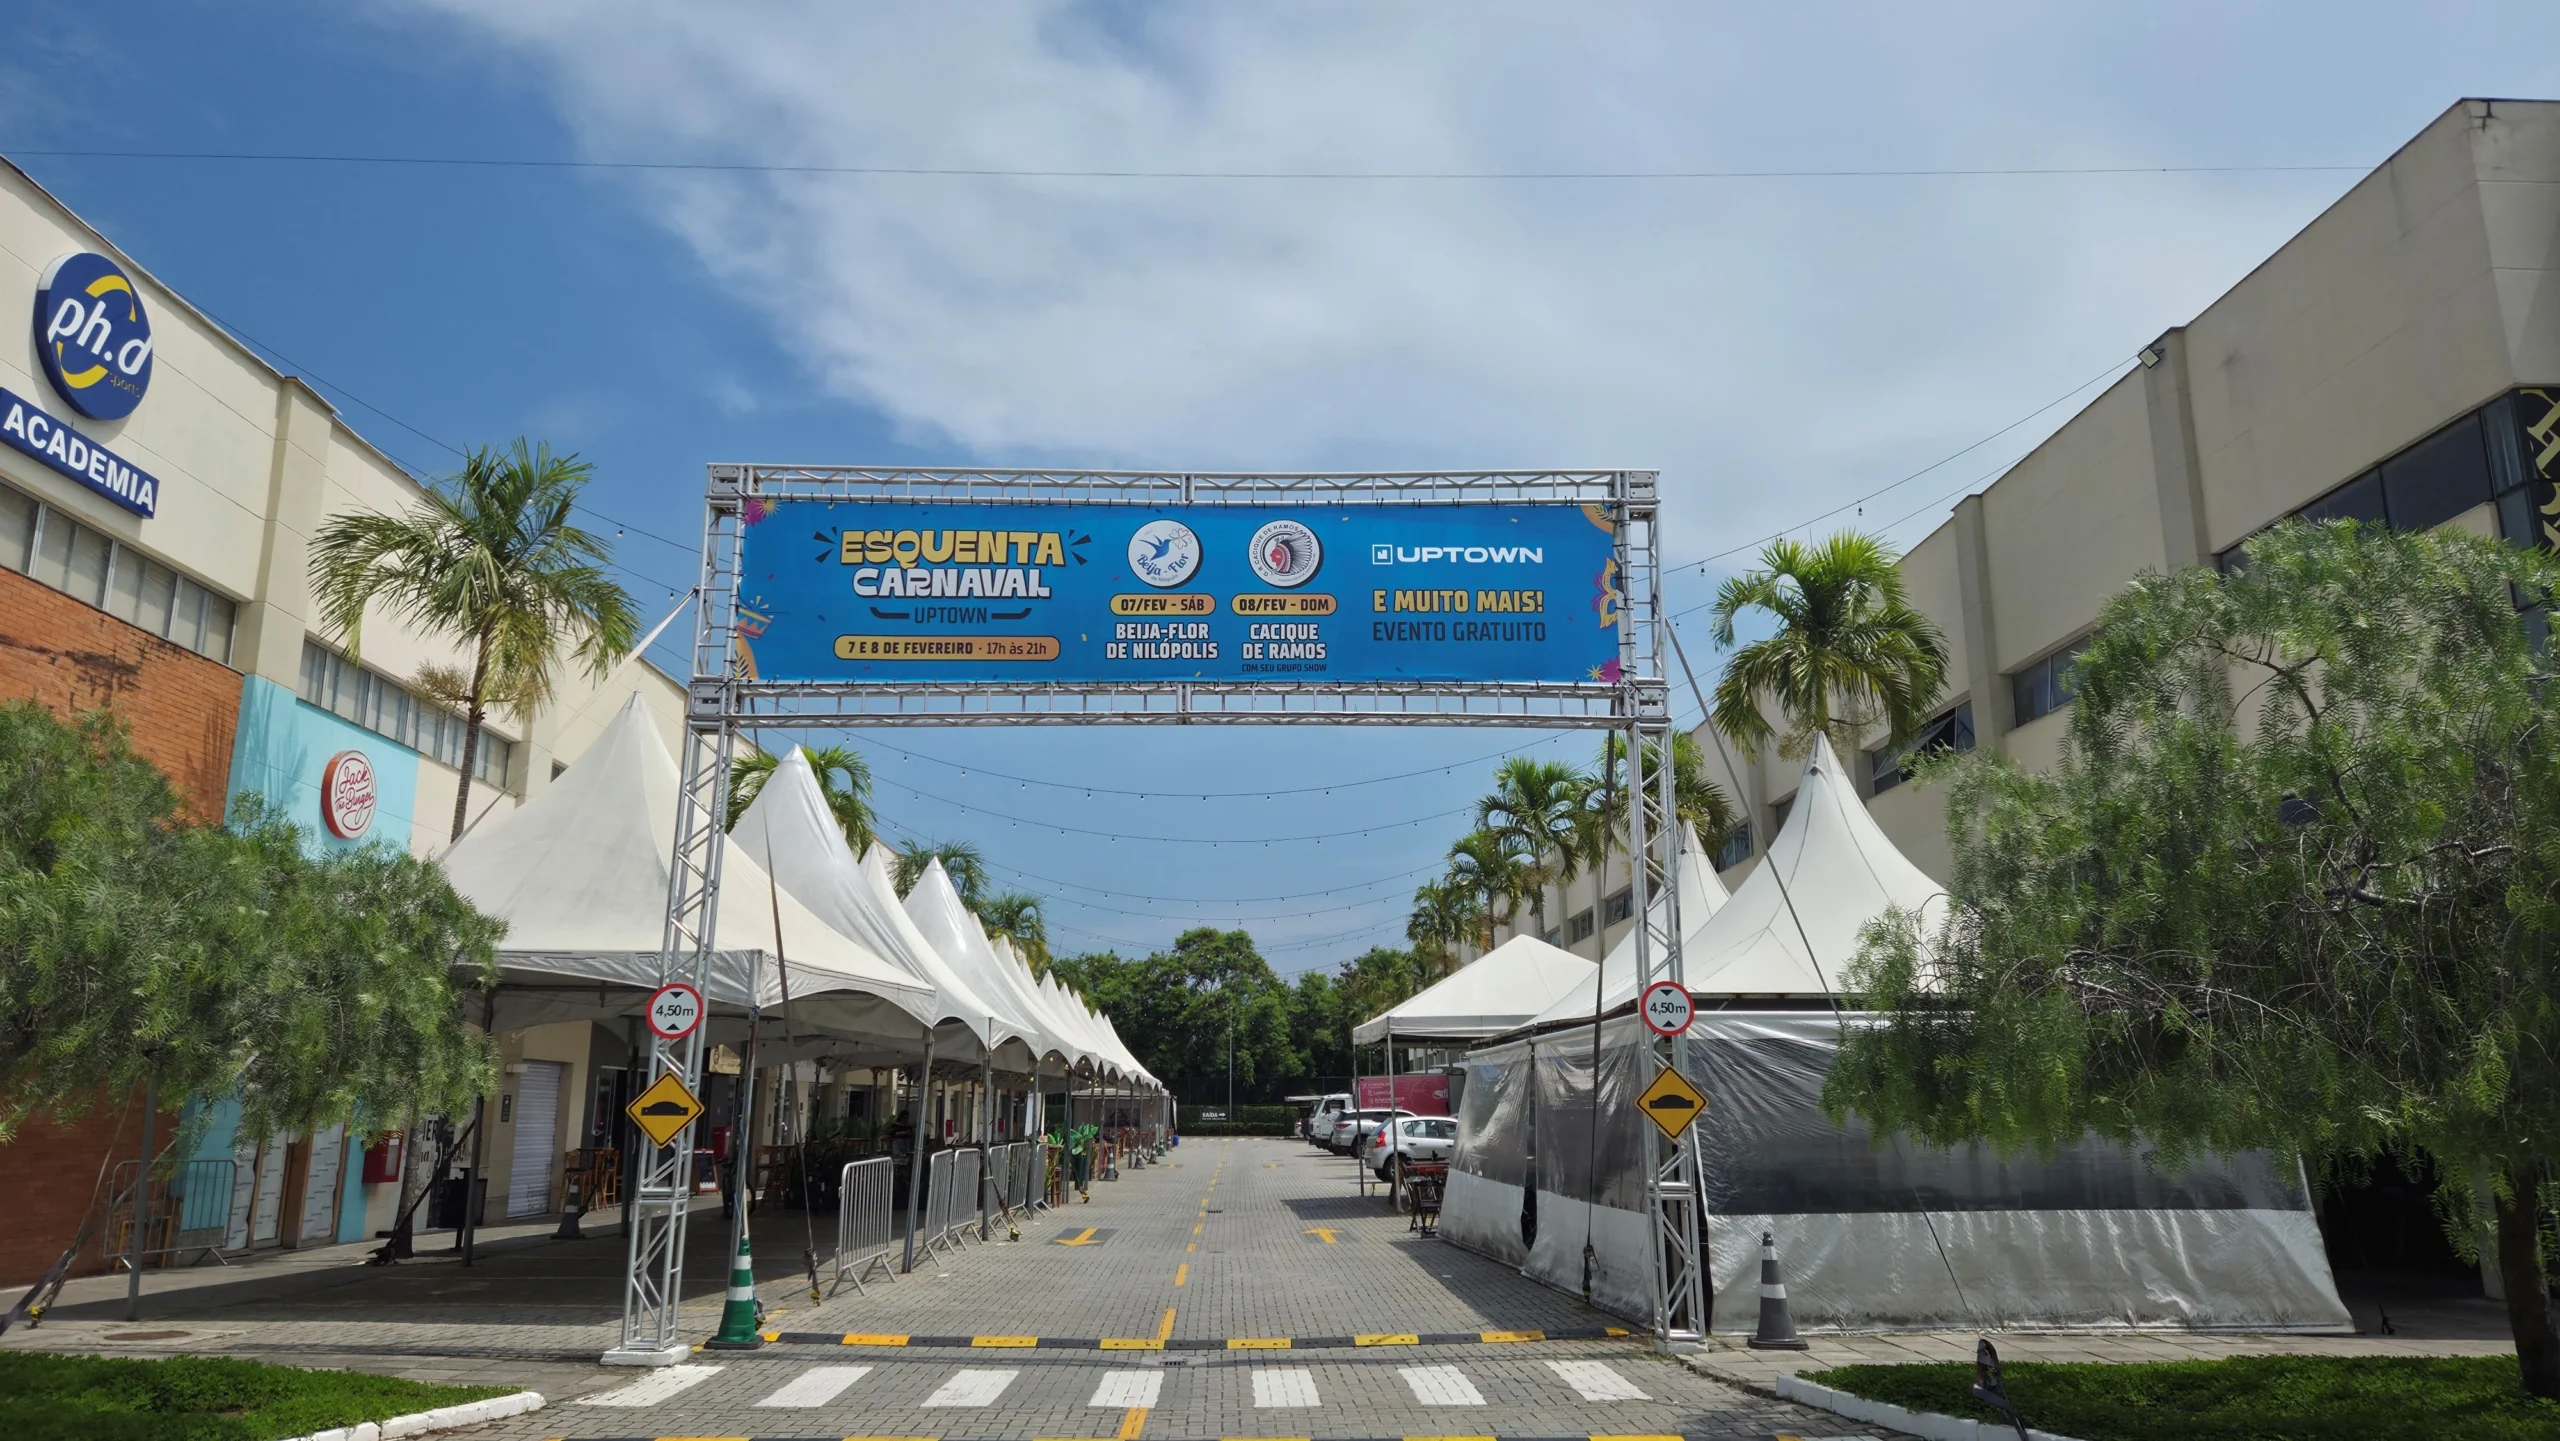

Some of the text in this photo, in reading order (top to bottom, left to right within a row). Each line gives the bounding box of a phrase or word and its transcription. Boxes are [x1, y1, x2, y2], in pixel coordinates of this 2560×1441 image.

[47, 298, 153, 376] ph.d
[109, 371, 141, 398] sports
[3, 403, 154, 513] ACADEMIA
[840, 529, 1066, 569] ESQUENTA
[1252, 536, 1265, 565] CACIQUE
[1263, 527, 1273, 536] DE
[1273, 524, 1299, 532] RAMOS
[1397, 547, 1543, 563] UPTOWN
[852, 567, 1051, 597] CARNAVAL
[1120, 598, 1168, 612] 07/FEV
[1180, 595, 1205, 611] SÁB
[1239, 598, 1287, 612] 08/FEV
[1300, 598, 1329, 611] DOM
[1373, 590, 1544, 613] E MUITO MAIS!
[914, 606, 987, 624] UPTOWN
[1115, 623, 1209, 639] BEIJA-FLOR
[1250, 623, 1318, 643] CACIQUE
[1373, 621, 1546, 642] EVENTO GRATUITO
[848, 641, 856, 654] 7
[859, 641, 867, 654] E
[870, 641, 879, 654] 8
[883, 641, 900, 654] DE
[903, 642, 973, 655] FEVEREIRO
[986, 642, 1006, 655] 17h
[1008, 642, 1024, 655] às
[1026, 642, 1047, 655] 21h
[1106, 638, 1218, 659] DE NILÓPOLIS
[1242, 643, 1326, 659] DE RAMOS
[1241, 663, 1327, 672] COM SEU GRUPO SHOW
[338, 762, 370, 794] Jack
[345, 787, 374, 820] Burger
